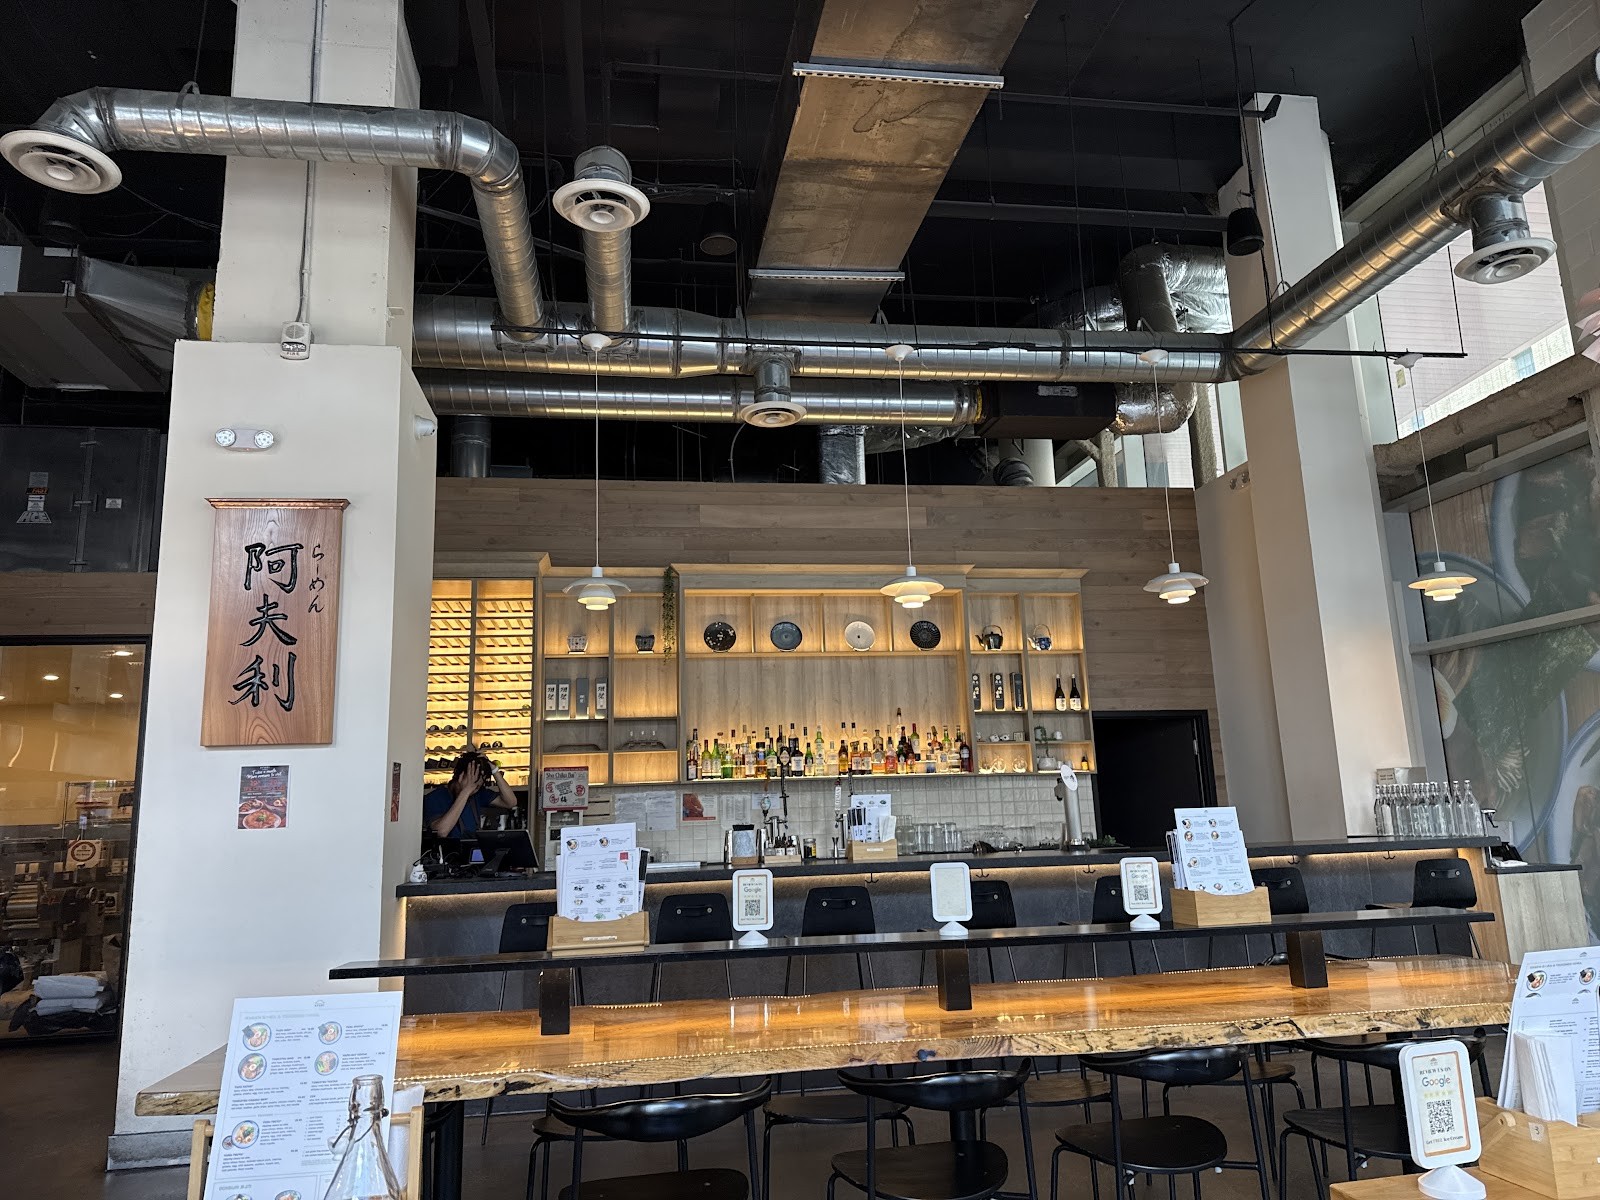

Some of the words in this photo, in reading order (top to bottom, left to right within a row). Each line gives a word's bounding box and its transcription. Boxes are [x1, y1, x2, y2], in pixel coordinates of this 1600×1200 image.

[308, 544, 325, 613] らーめん
[228, 543, 304, 712] 阿夫利
[1421, 1074, 1451, 1088] Google
